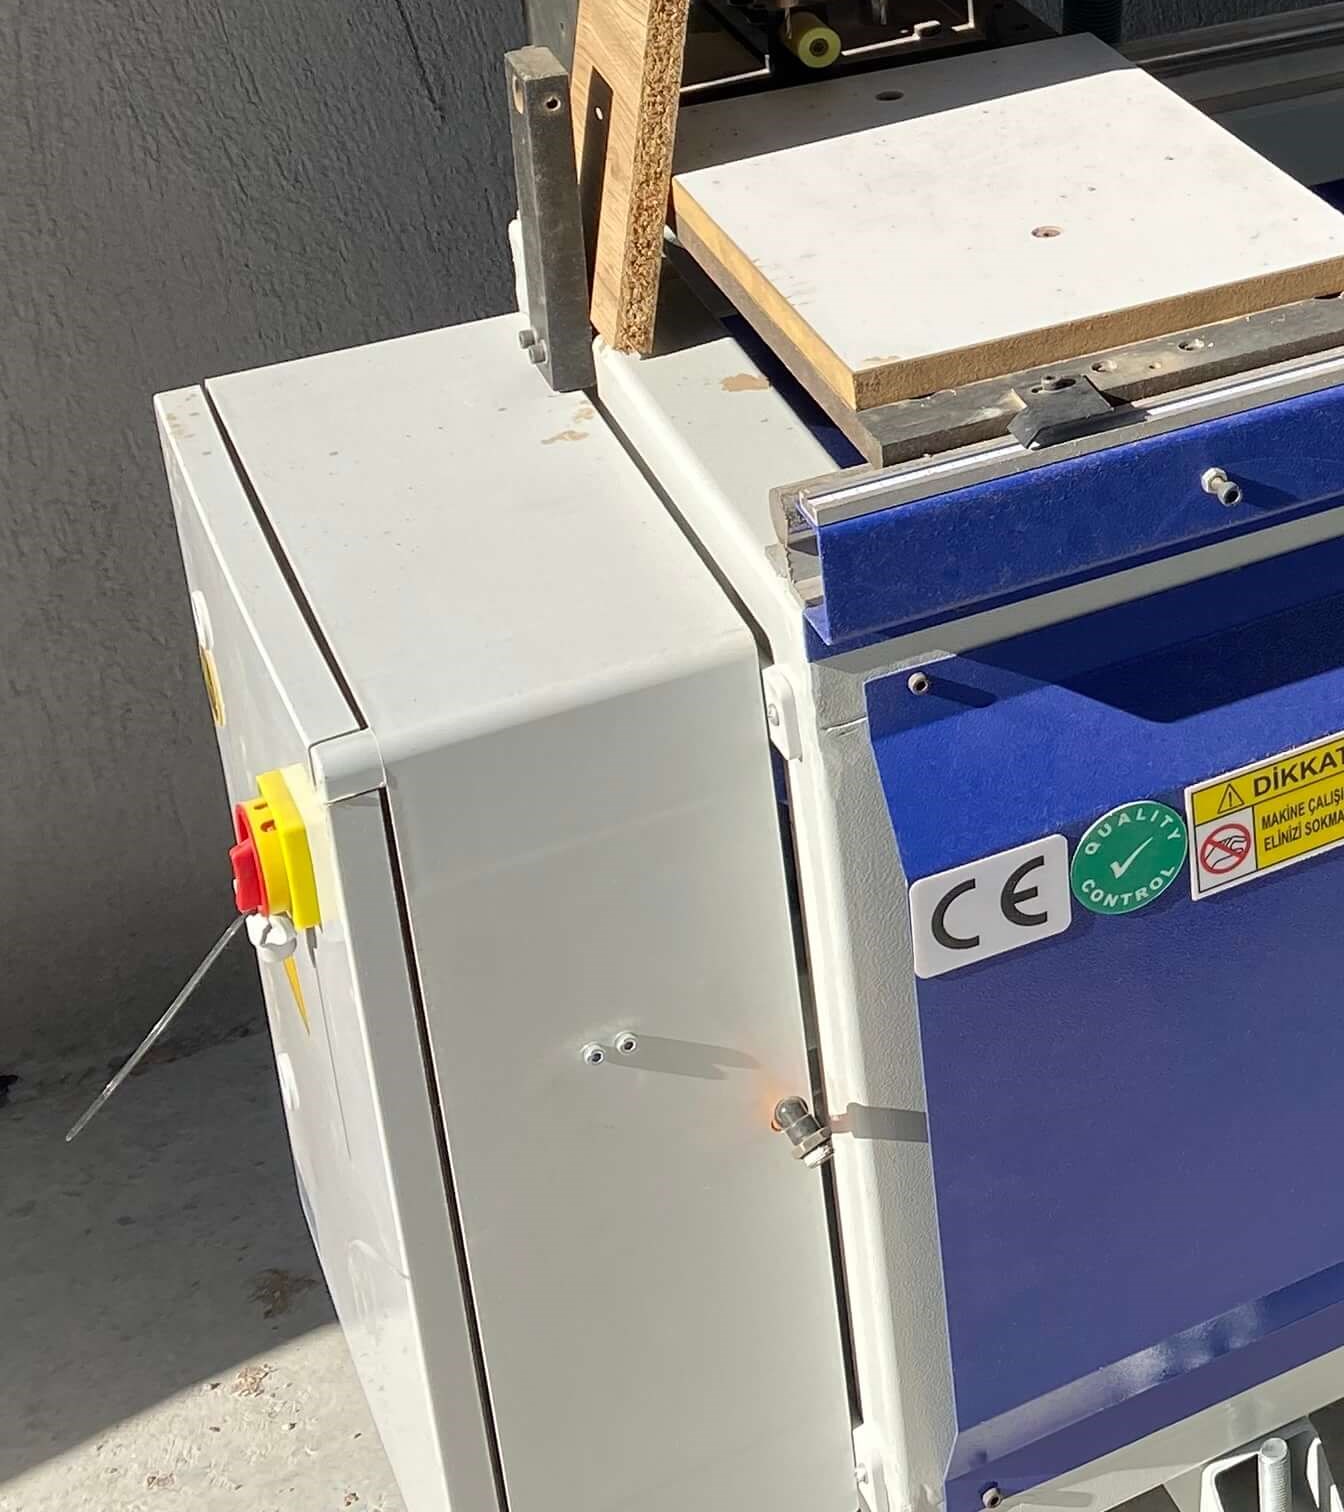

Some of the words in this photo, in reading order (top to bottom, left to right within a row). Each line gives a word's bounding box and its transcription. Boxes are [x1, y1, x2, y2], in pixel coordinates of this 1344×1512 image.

[1084, 808, 1181, 855] QUALITY
[1261, 802, 1305, 830] MAKİNE
[1263, 821, 1302, 852] ELİNİZİ
[931, 855, 1048, 949] CE
[1081, 867, 1175, 907] CONTROL
